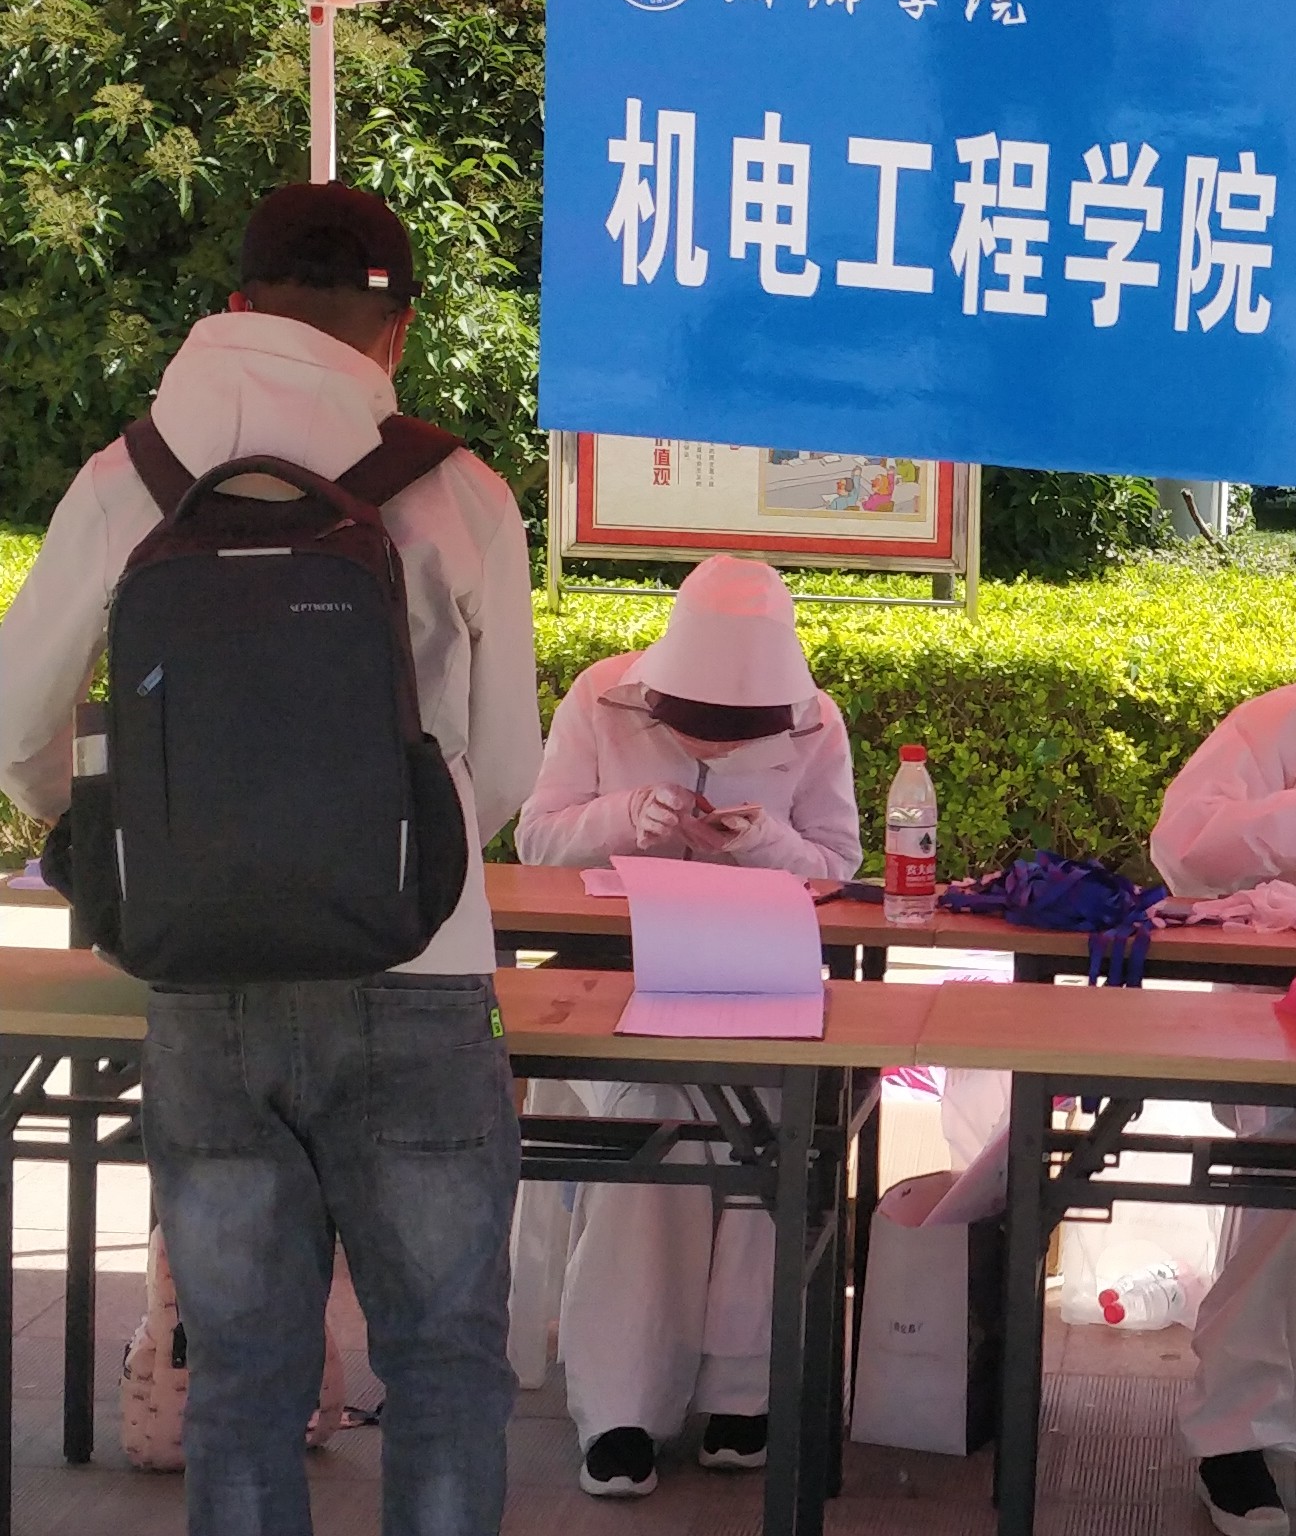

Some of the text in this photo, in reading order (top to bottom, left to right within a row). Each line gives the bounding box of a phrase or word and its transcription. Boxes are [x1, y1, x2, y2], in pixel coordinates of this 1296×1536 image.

[604, 96, 1279, 336] 机电工程学院
[652, 438, 671, 486] 值观
